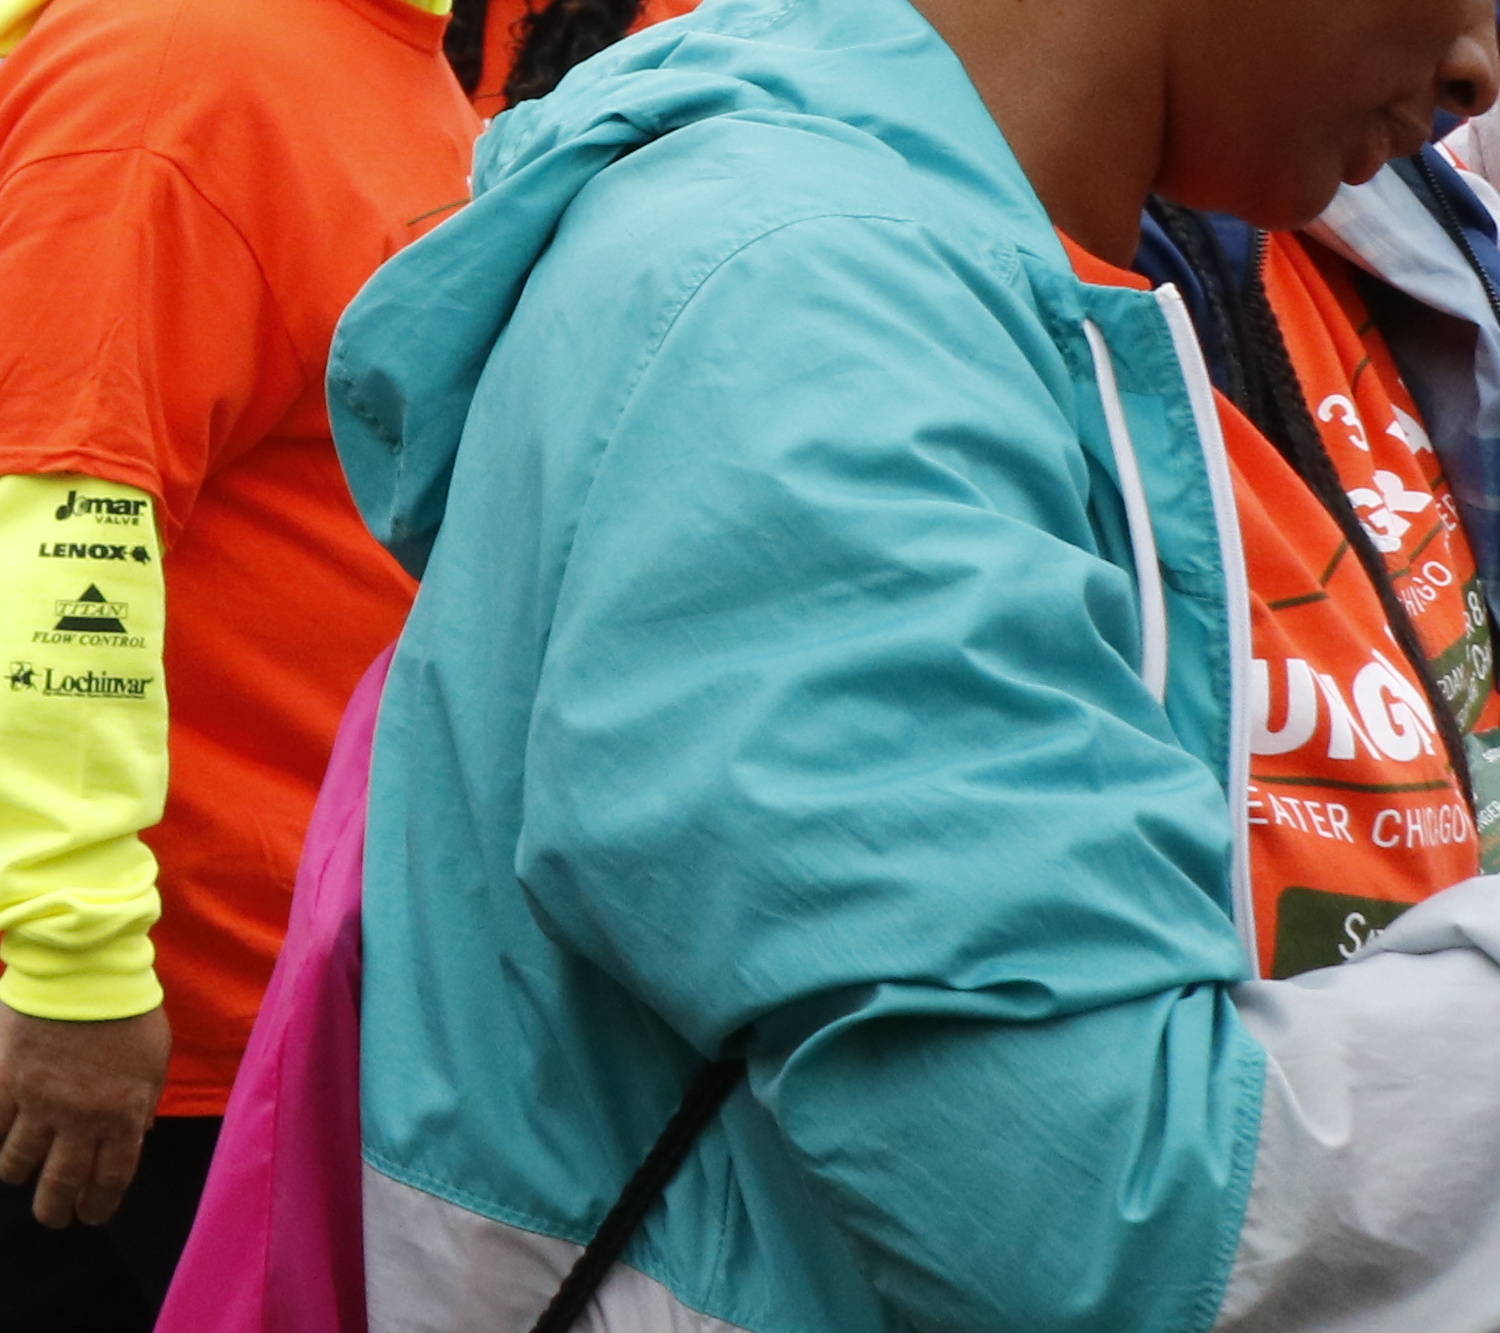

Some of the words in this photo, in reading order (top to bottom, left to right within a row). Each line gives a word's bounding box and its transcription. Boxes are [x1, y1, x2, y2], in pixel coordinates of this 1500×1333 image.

[95, 515, 140, 526] VALVE
[38, 542, 127, 560] LENOX
[57, 603, 126, 617] TITAN
[31, 631, 76, 644] FLOW
[79, 633, 148, 649] CONTROL
[42, 667, 154, 695] Lochinvar
